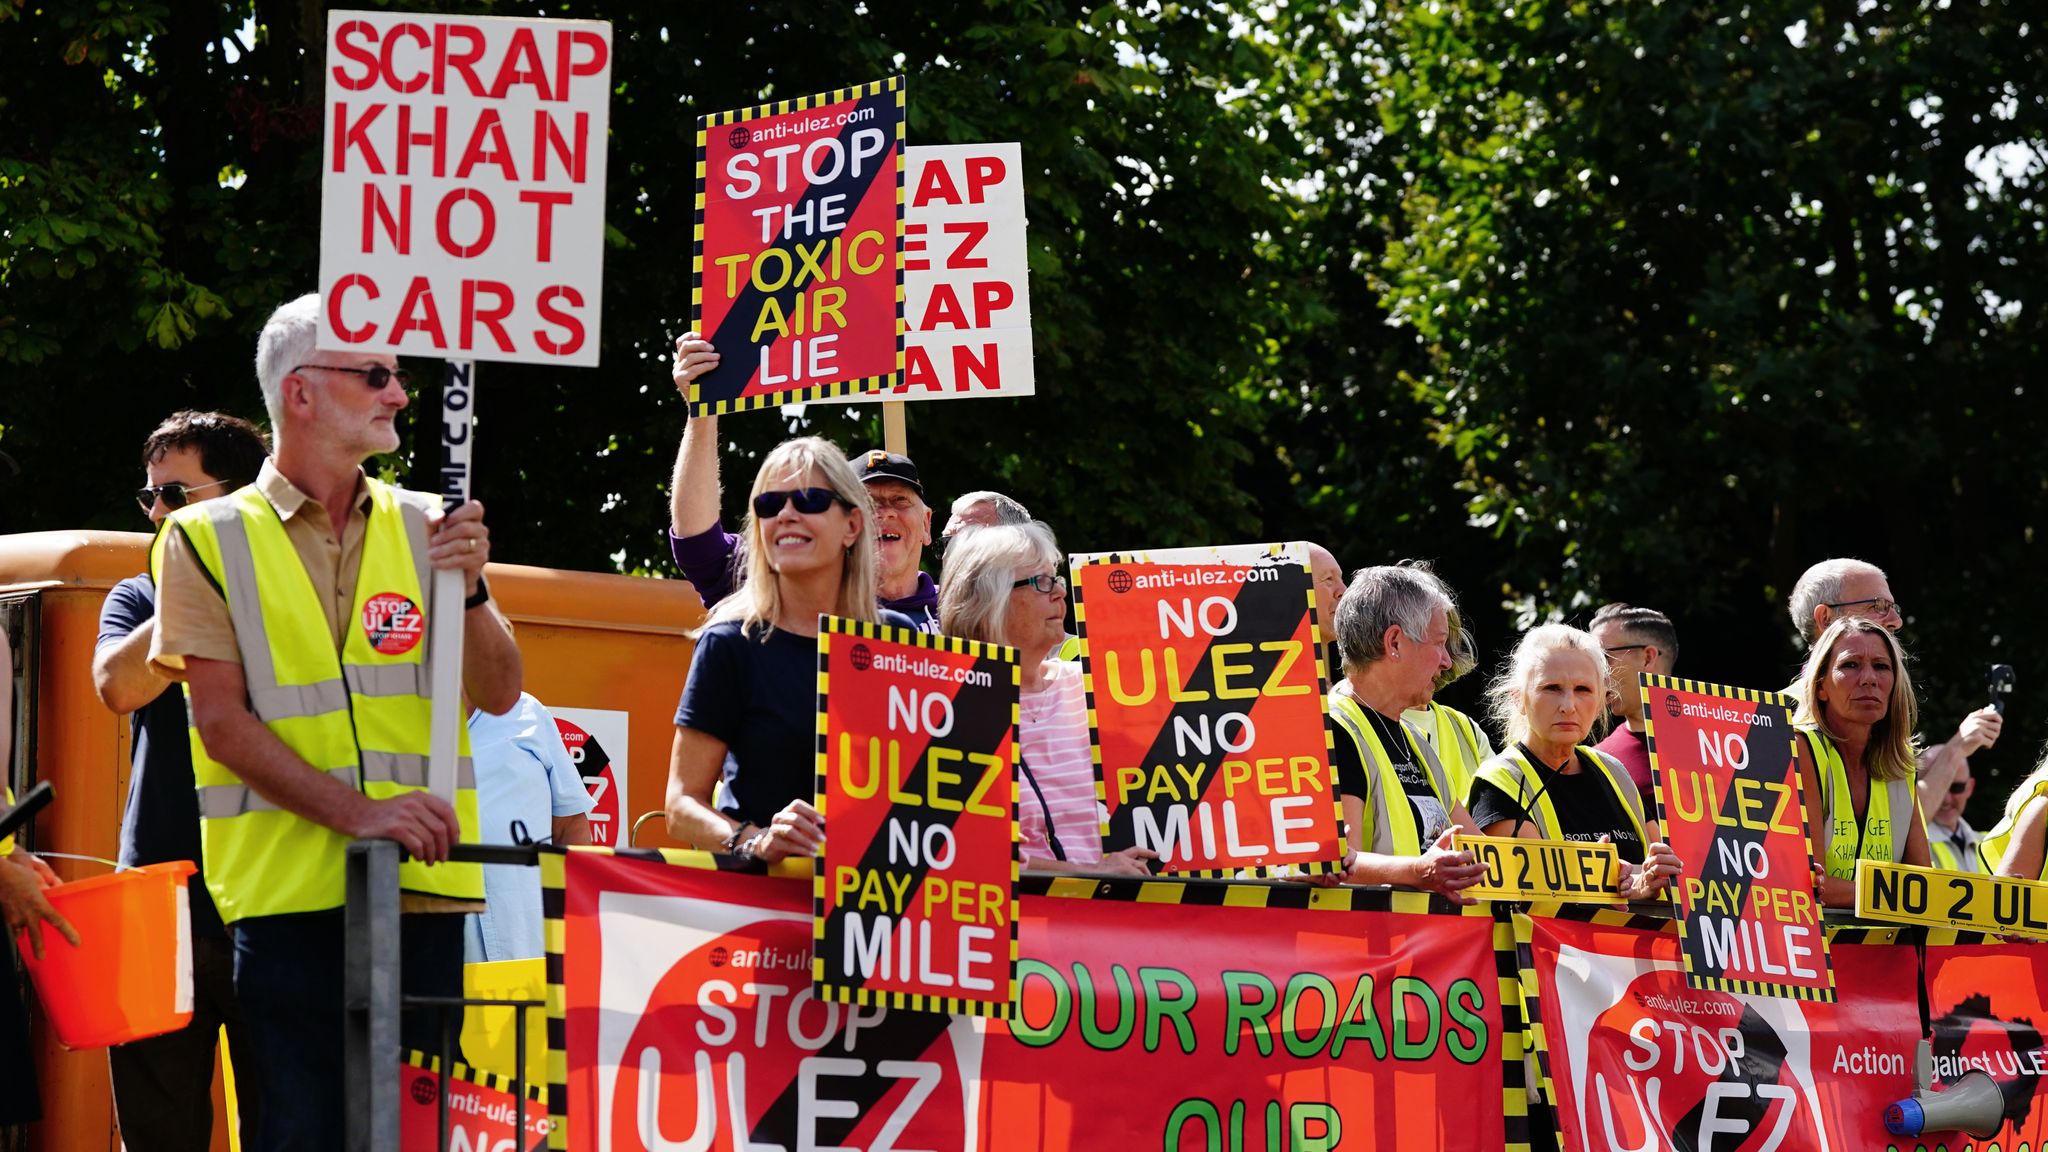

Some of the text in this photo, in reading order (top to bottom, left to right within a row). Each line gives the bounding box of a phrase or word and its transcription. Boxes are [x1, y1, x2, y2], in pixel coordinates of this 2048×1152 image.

[332, 20, 608, 101] SCRAP
[332, 102, 589, 183] KHAN
[752, 107, 875, 143] anti-ulez.com
[725, 127, 885, 200] STOP
[361, 182, 574, 263] NOT
[752, 193, 847, 244] THE
[714, 230, 885, 299] TOXIC
[327, 273, 586, 356] CARS
[750, 286, 848, 343] AIR
[905, 281, 1015, 332] AP
[444, 362, 471, 411] NO
[759, 334, 840, 386] LIE
[866, 451, 888, 469] P
[1135, 567, 1279, 590] anti-ulez.com
[362, 611, 421, 632] ULEZ
[367, 600, 412, 614] STOP
[1157, 595, 1238, 640] NO
[873, 650, 992, 687] anti-ulez.com
[1105, 640, 1312, 706] ULEZ
[887, 684, 955, 738] NO
[1173, 712, 1256, 757] NO
[1682, 701, 1773, 728] anti-ulez.com
[838, 731, 1006, 818] ULEZ
[1697, 728, 1749, 771] NO
[1116, 755, 1324, 805] PAY PER
[1668, 767, 1800, 835] ULEZ
[888, 816, 956, 870] NO
[1132, 795, 1320, 863] MILE
[1563, 832, 1592, 841] som
[1512, 846, 1534, 890] 2
[1540, 846, 1618, 894] ULEZ
[1716, 836, 1770, 880] NO
[835, 864, 1005, 927] PAY PER
[1684, 877, 1815, 926] PAY PER
[1872, 868, 1928, 915] NO
[1948, 878, 1974, 921] 2
[843, 911, 995, 991] MILE
[1698, 915, 1818, 979] MILE
[695, 980, 887, 1052] STOP
[1007, 958, 1489, 1064] OUR ROADS
[1645, 994, 1736, 1016] anti-ulez.com
[1623, 1018, 1746, 1077] STOP
[1832, 1044, 1905, 1076] Action
[1911, 1048, 1997, 1083] gainst
[637, 1045, 942, 1152] ULEZ
[1163, 1098, 1343, 1152] OUR
